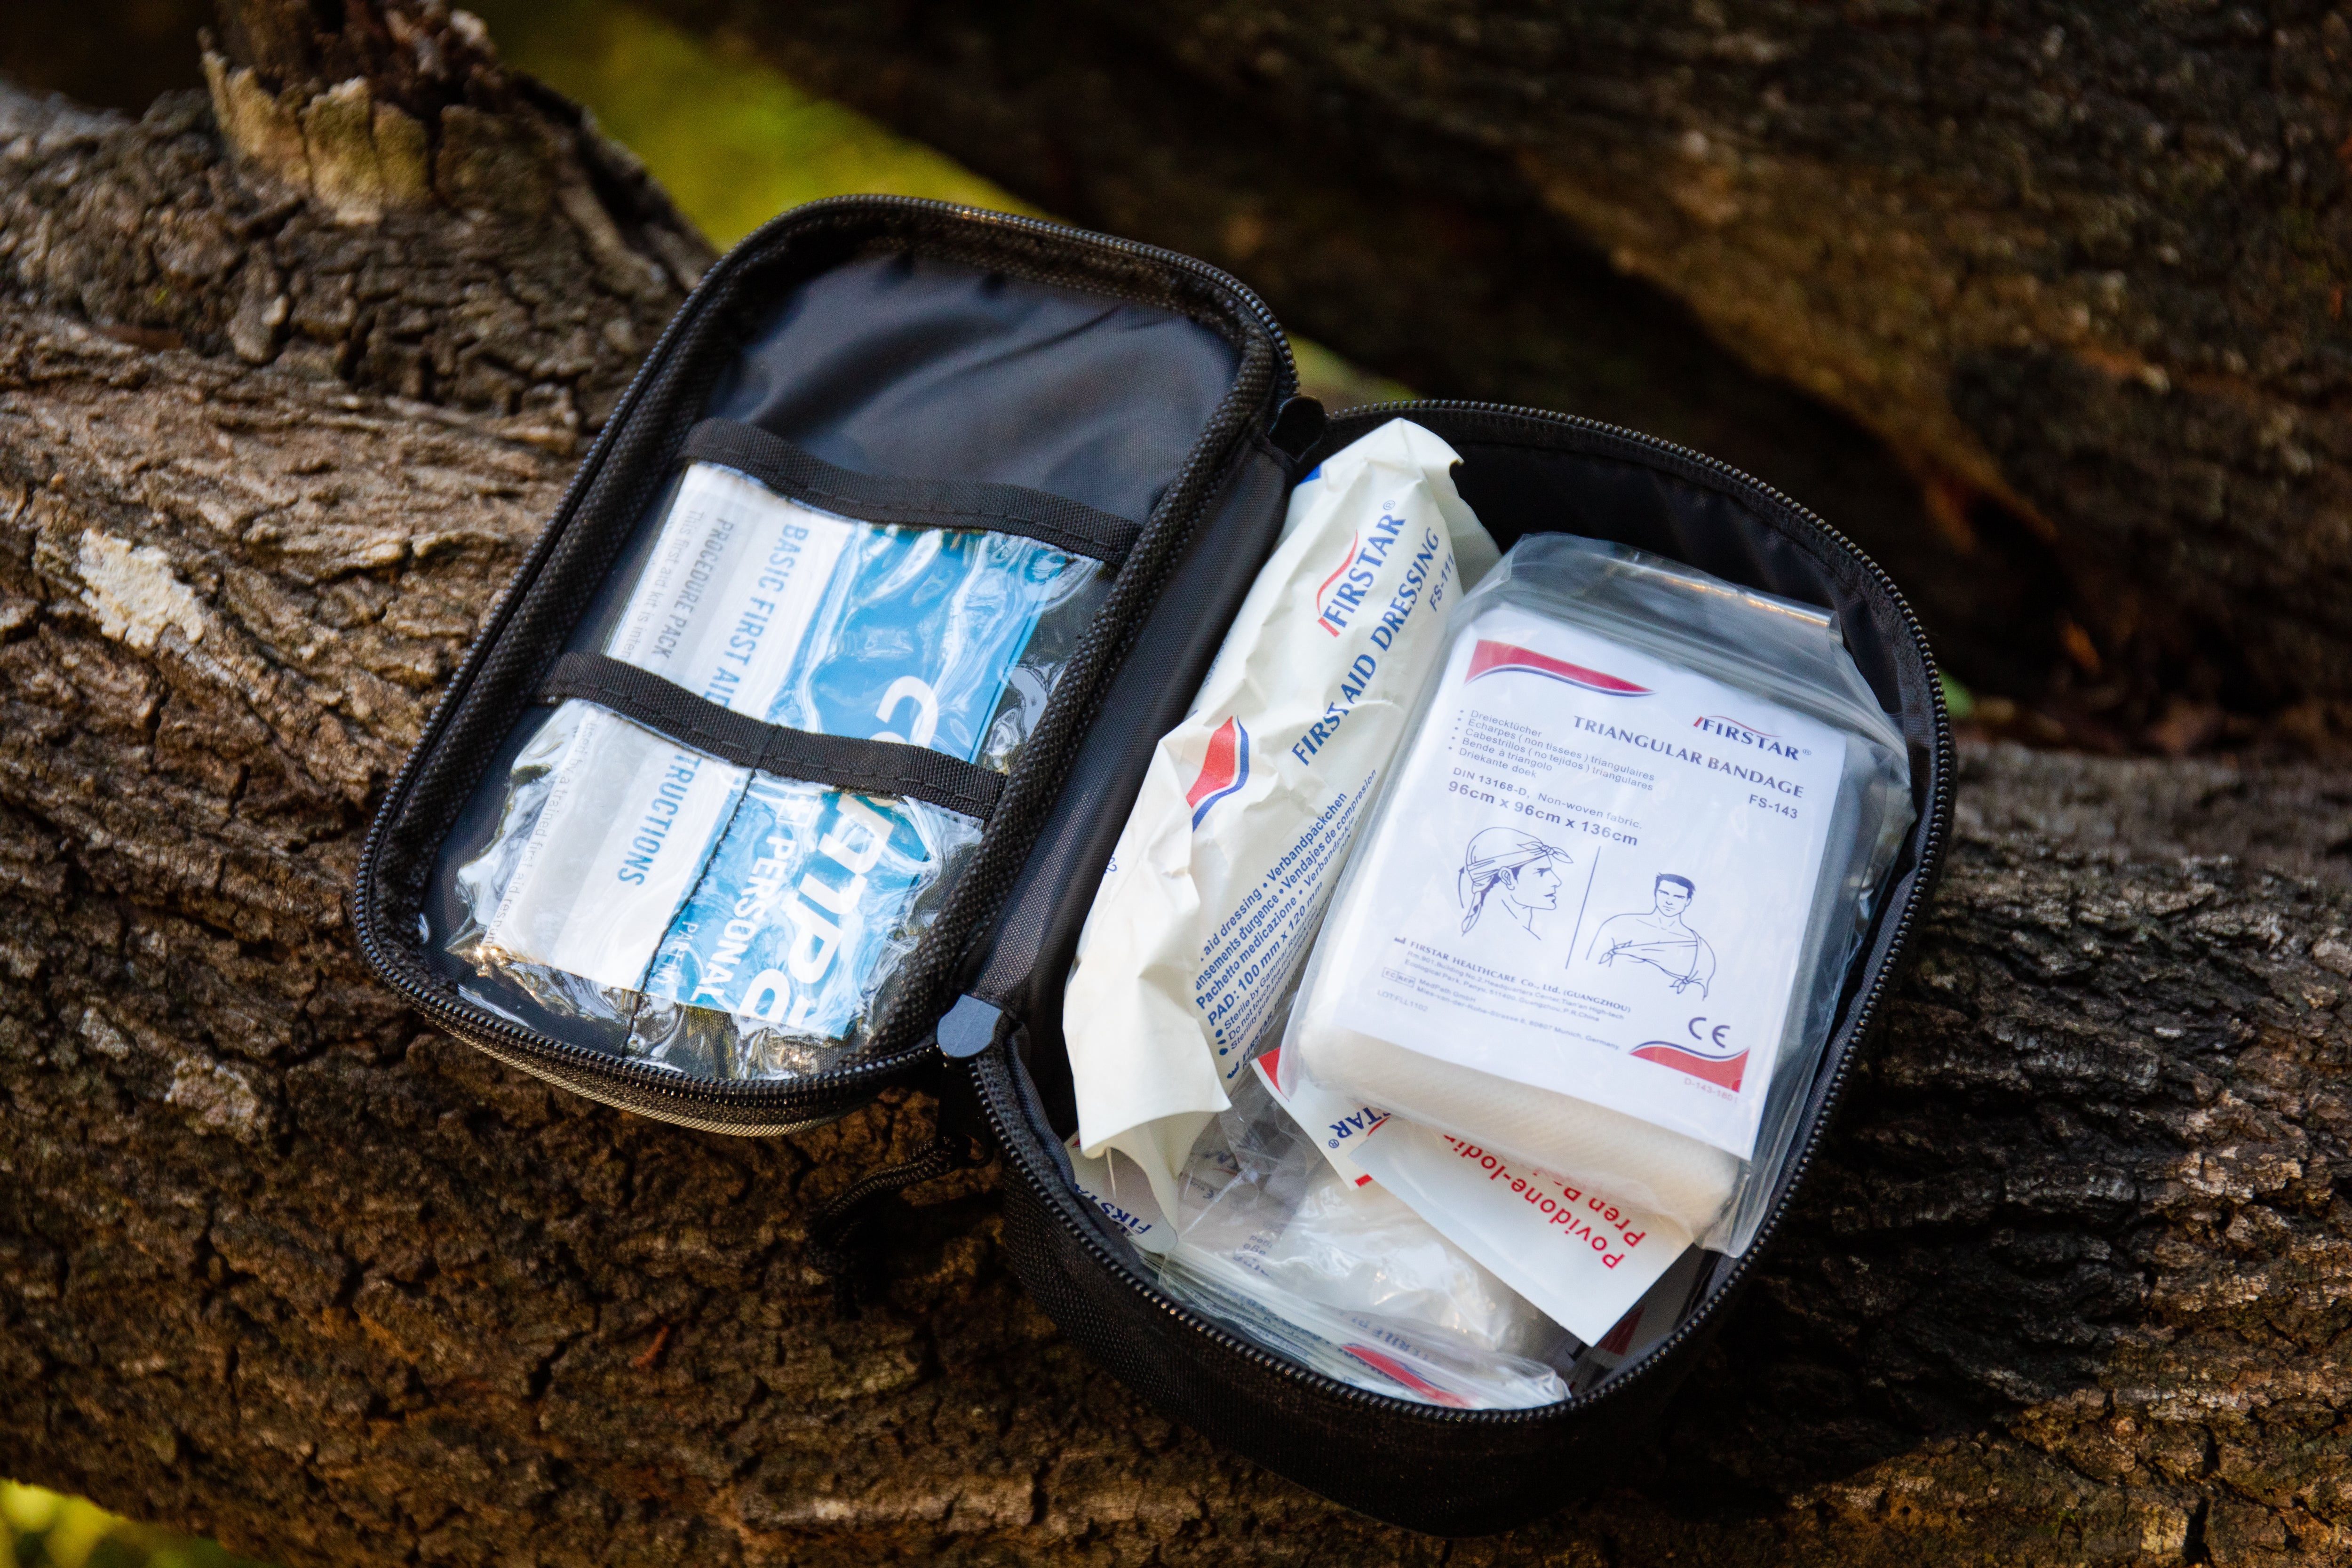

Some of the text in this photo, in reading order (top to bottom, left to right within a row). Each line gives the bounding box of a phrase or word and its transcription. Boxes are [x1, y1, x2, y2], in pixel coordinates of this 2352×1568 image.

[620, 510, 704, 659] This first aid kit is inten
[652, 518, 734, 660] PROCEDURE PACK
[758, 524, 810, 592] BASIC
[1429, 553, 1458, 612] FS-111
[724, 597, 775, 666] FIRST
[1292, 527, 1439, 766] FIRST AID DRESSING
[574, 723, 597, 755] used
[1462, 737, 1495, 754] Bende
[1507, 752, 1552, 771] triangolo
[1468, 718, 1516, 740] Echarpes
[1546, 742, 1582, 759] tissees
[1590, 756, 1655, 781] triangulaires
[1470, 710, 1542, 737] Dreiecktücher
[568, 757, 584, 773] by
[1459, 748, 1536, 778] Driekante doek
[1465, 728, 1526, 753] Cabestrillos
[1549, 754, 1583, 770] tejidos
[1592, 767, 1653, 791] triangulares
[1575, 716, 1804, 798] TRIANGULAR BANDAGE
[534, 788, 568, 837] trained
[618, 749, 701, 885] TRUCTIONS
[1448, 780, 1638, 846] 96cm x 96cm x 136cm
[1453, 767, 1642, 829] DIN 13168-D, Non-woven fabric.
[1748, 794, 1798, 819] FS-143
[509, 872, 525, 894] aid
[522, 841, 543, 868] first
[1196, 938, 1241, 991] ansements
[1239, 895, 1279, 940] d'urgence
[1280, 842, 1325, 889] Vendajes
[1324, 828, 1337, 844] de
[1336, 769, 1376, 831] compresion
[1203, 793, 1347, 955] aid dressing Verbandpäckchen
[666, 919, 699, 961] PART
[690, 835, 797, 1000] PERSONAL
[1195, 961, 1240, 1010] Pachetto
[1239, 897, 1297, 963] medicazione
[1208, 881, 1322, 1027] PAD: 100 mm x 120 mm
[1411, 941, 1631, 1013] FIRSTAR HEALTHCARE Co., Ltd. (GUANGZHOU)
[1224, 999, 1250, 1030] Sterile
[1250, 987, 1259, 1000] by
[1260, 948, 1287, 987] Gammar
[1228, 1026, 1241, 1040] Do
[1241, 1008, 1253, 1026] not
[1252, 984, 1271, 1011] touch
[1271, 969, 1281, 984] the
[1230, 1014, 1257, 1050] Sterility
[1257, 960, 1291, 1015] guaranteed
[1243, 1011, 1272, 1062] FIRSTAR
[1688, 1017, 1731, 1049] CE
